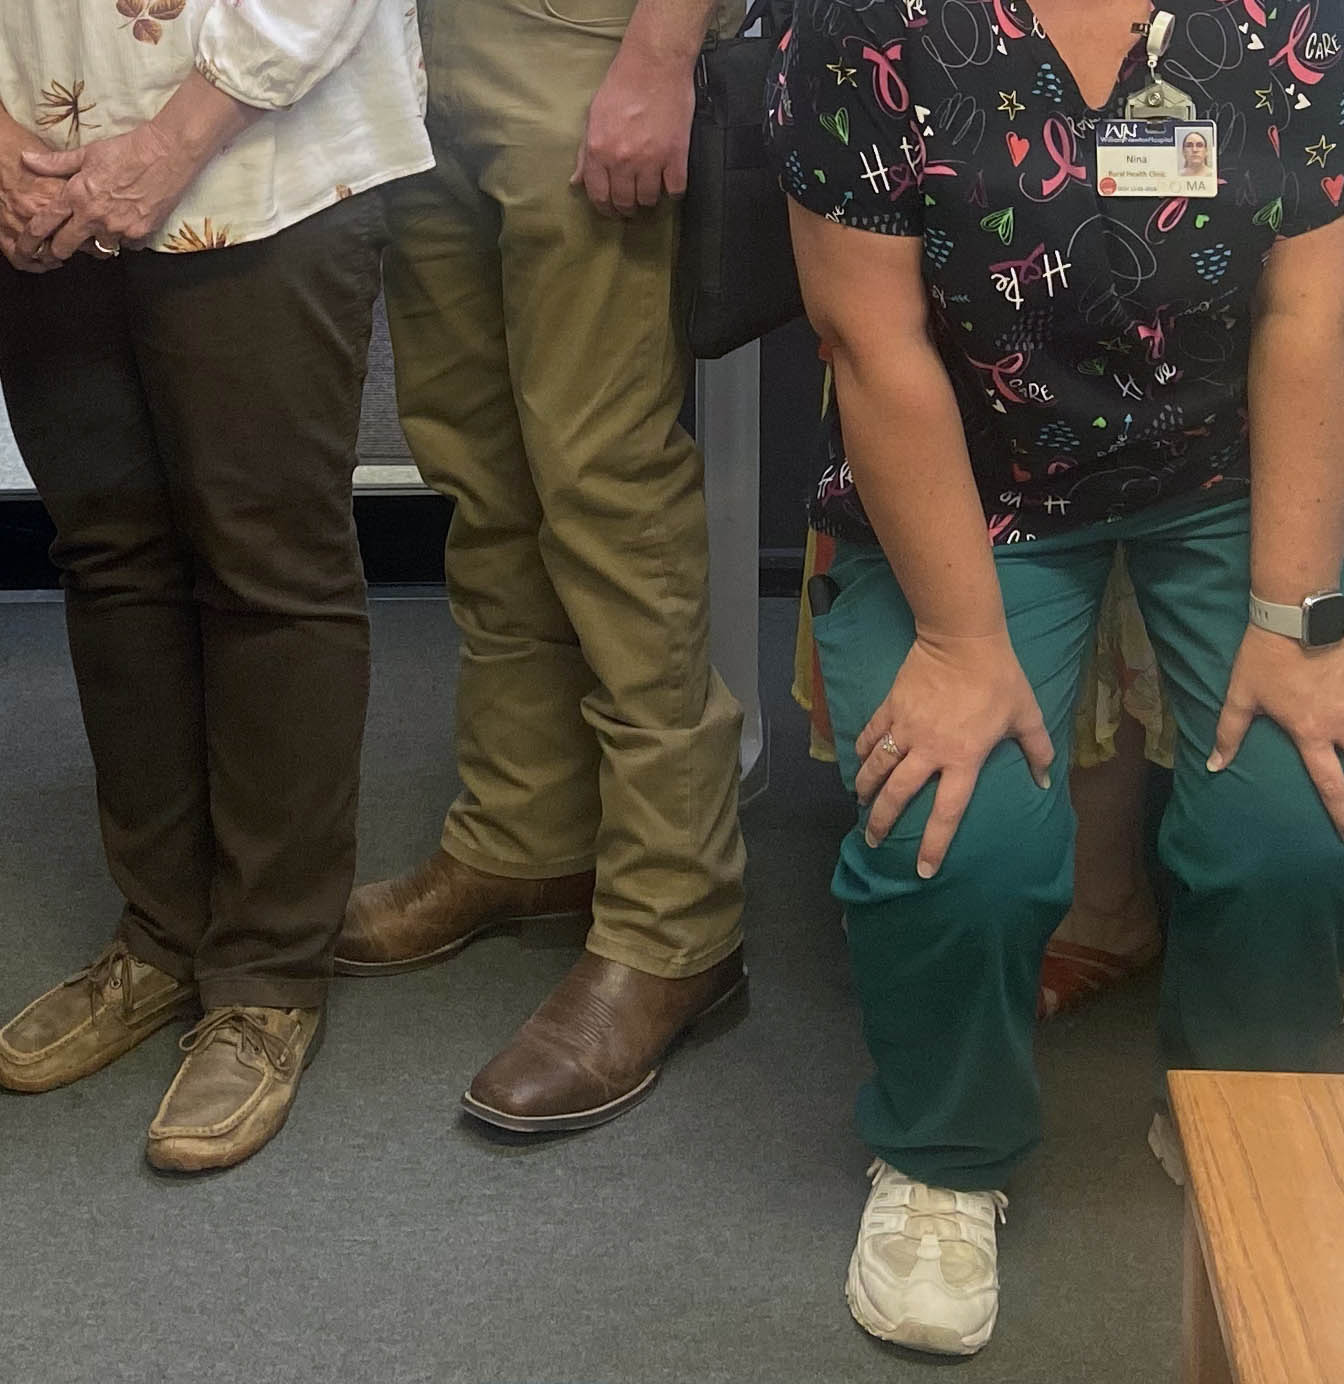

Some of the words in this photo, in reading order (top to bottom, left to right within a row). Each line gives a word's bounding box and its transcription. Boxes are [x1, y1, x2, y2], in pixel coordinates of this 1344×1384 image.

[1306, 32, 1343, 60] CARE
[1126, 155, 1147, 163] Nina
[1186, 181, 1206, 191] MA
